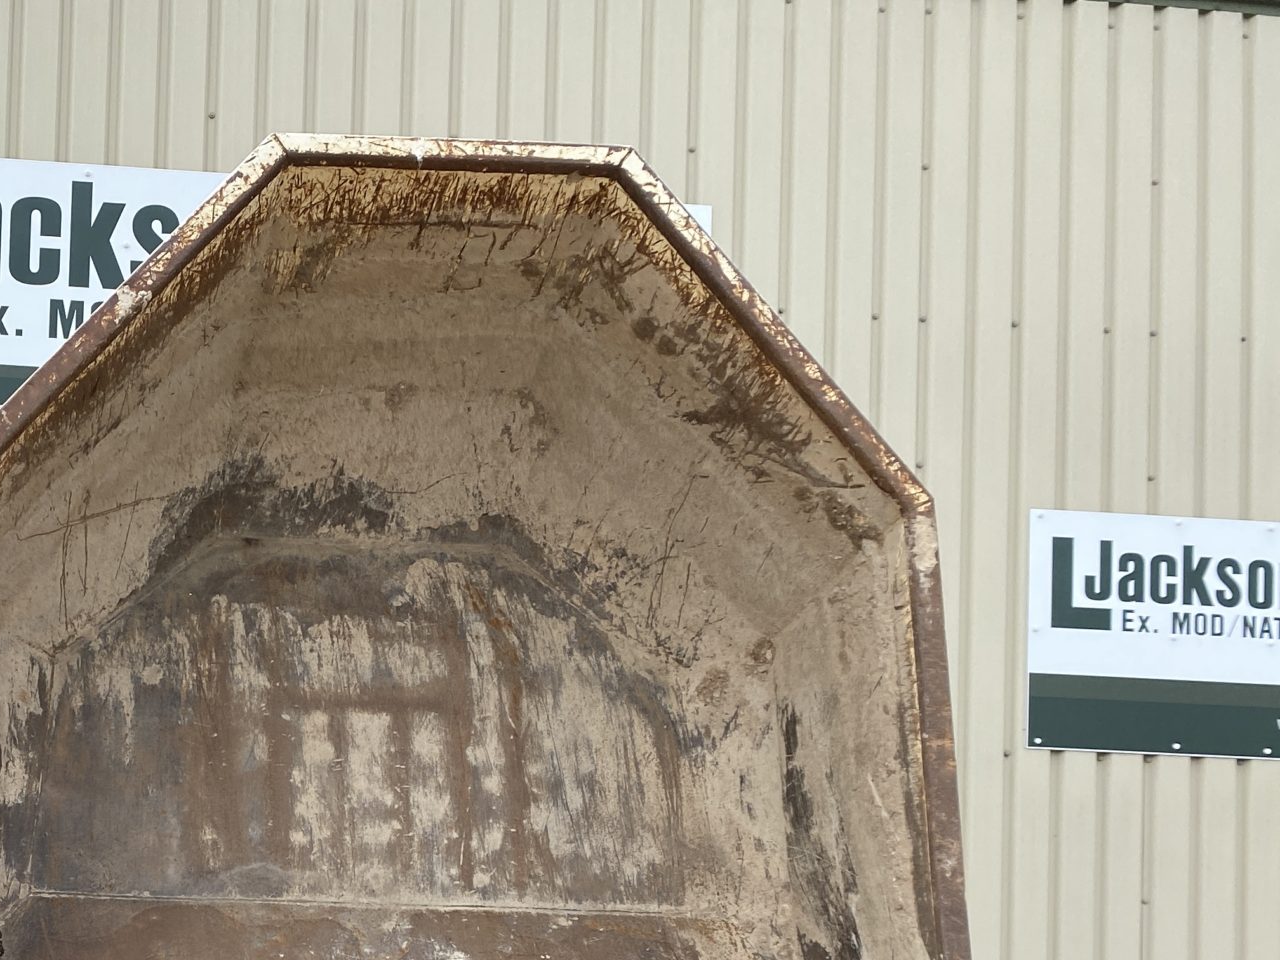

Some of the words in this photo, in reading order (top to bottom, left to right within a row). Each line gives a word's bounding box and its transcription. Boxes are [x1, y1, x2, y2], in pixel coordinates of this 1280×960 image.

[48, 298, 105, 339] M
[1051, 536, 1280, 630] LJackso
[1122, 610, 1159, 634] Ex.
